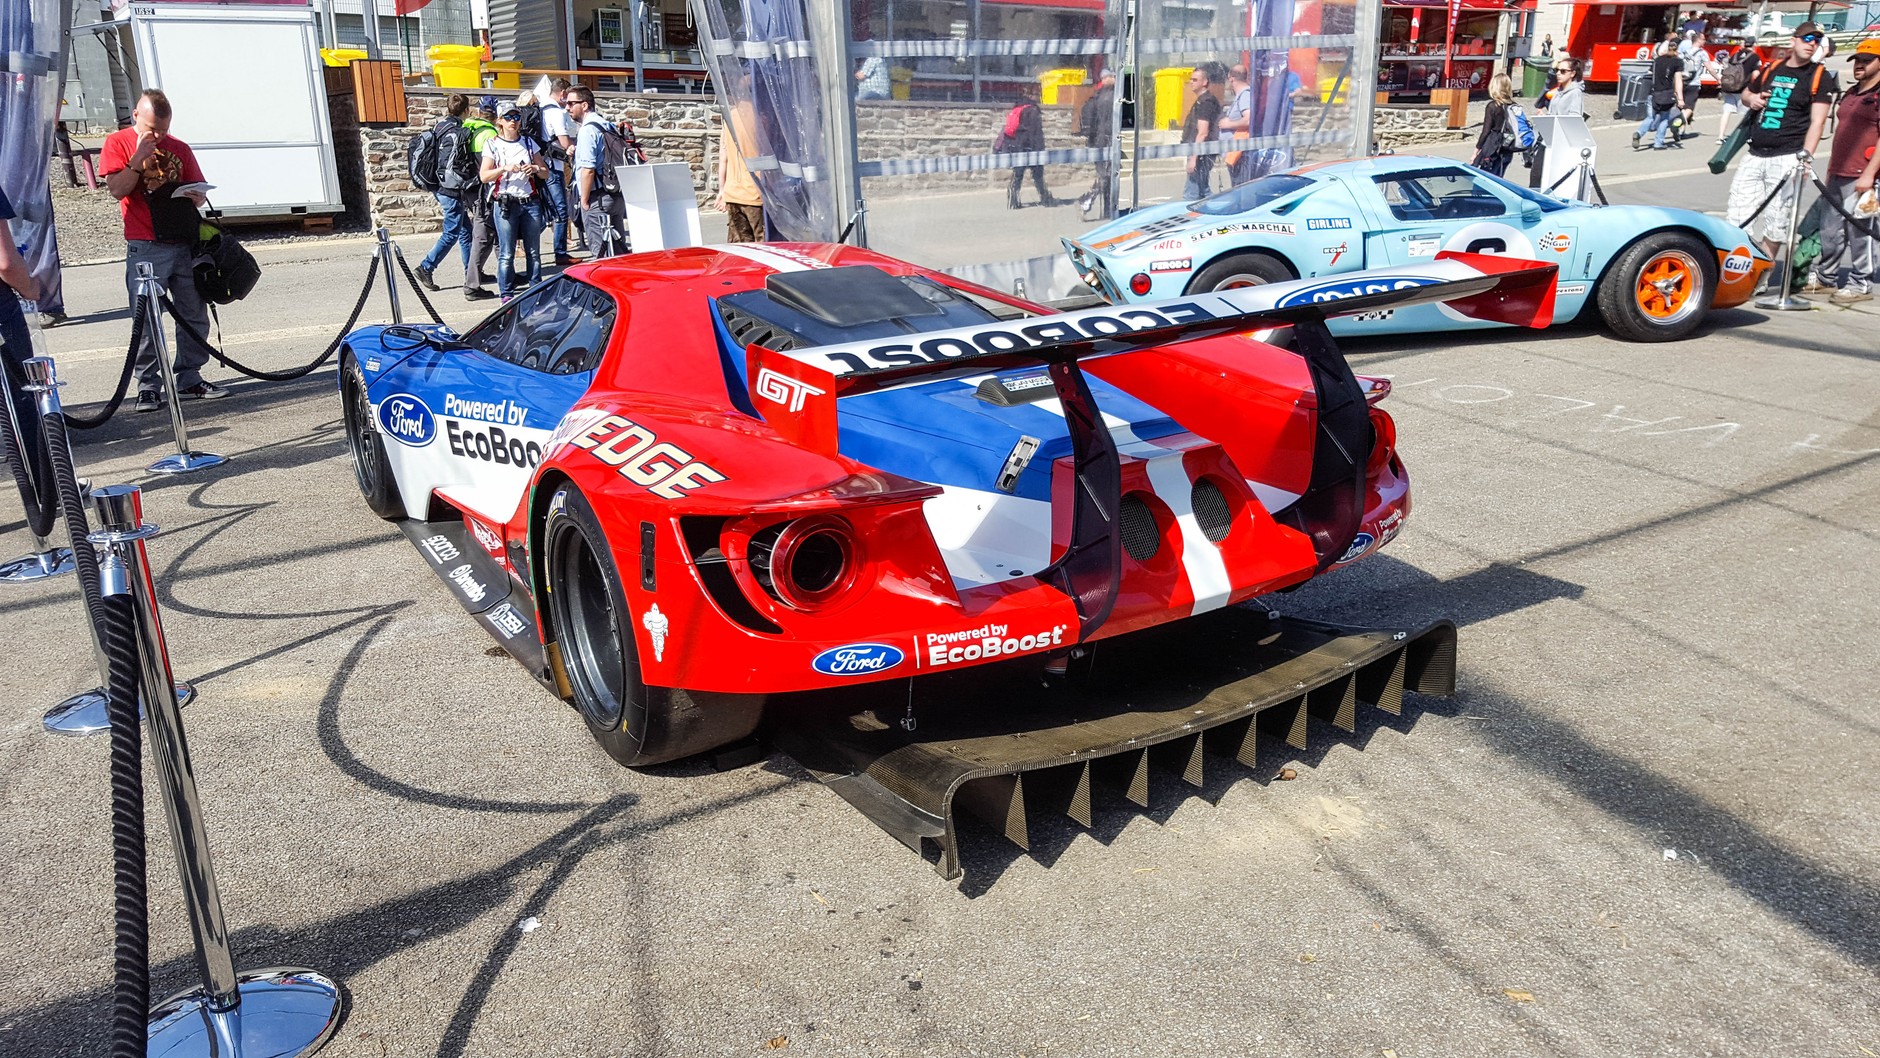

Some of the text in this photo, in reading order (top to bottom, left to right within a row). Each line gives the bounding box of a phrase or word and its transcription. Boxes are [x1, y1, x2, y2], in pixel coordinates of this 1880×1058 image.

[1450, 78, 1472, 89] PASTA
[1761, 87, 1792, 129] 2014
[1242, 223, 1294, 234] MARCHAL
[1308, 219, 1350, 230] GIRLING
[1152, 260, 1190, 271] FERODO
[1725, 257, 1752, 271] Gulf
[756, 367, 826, 413] GT
[390, 399, 425, 439] Ford
[444, 393, 528, 427] Powered by
[446, 420, 542, 469] EcoBoo
[570, 414, 730, 500] EDGE
[424, 534, 461, 562] sparco
[457, 570, 487, 603] brembo
[927, 624, 1008, 646] Powered by
[929, 625, 1063, 666] EcoBoost
[830, 648, 886, 672] Ford
